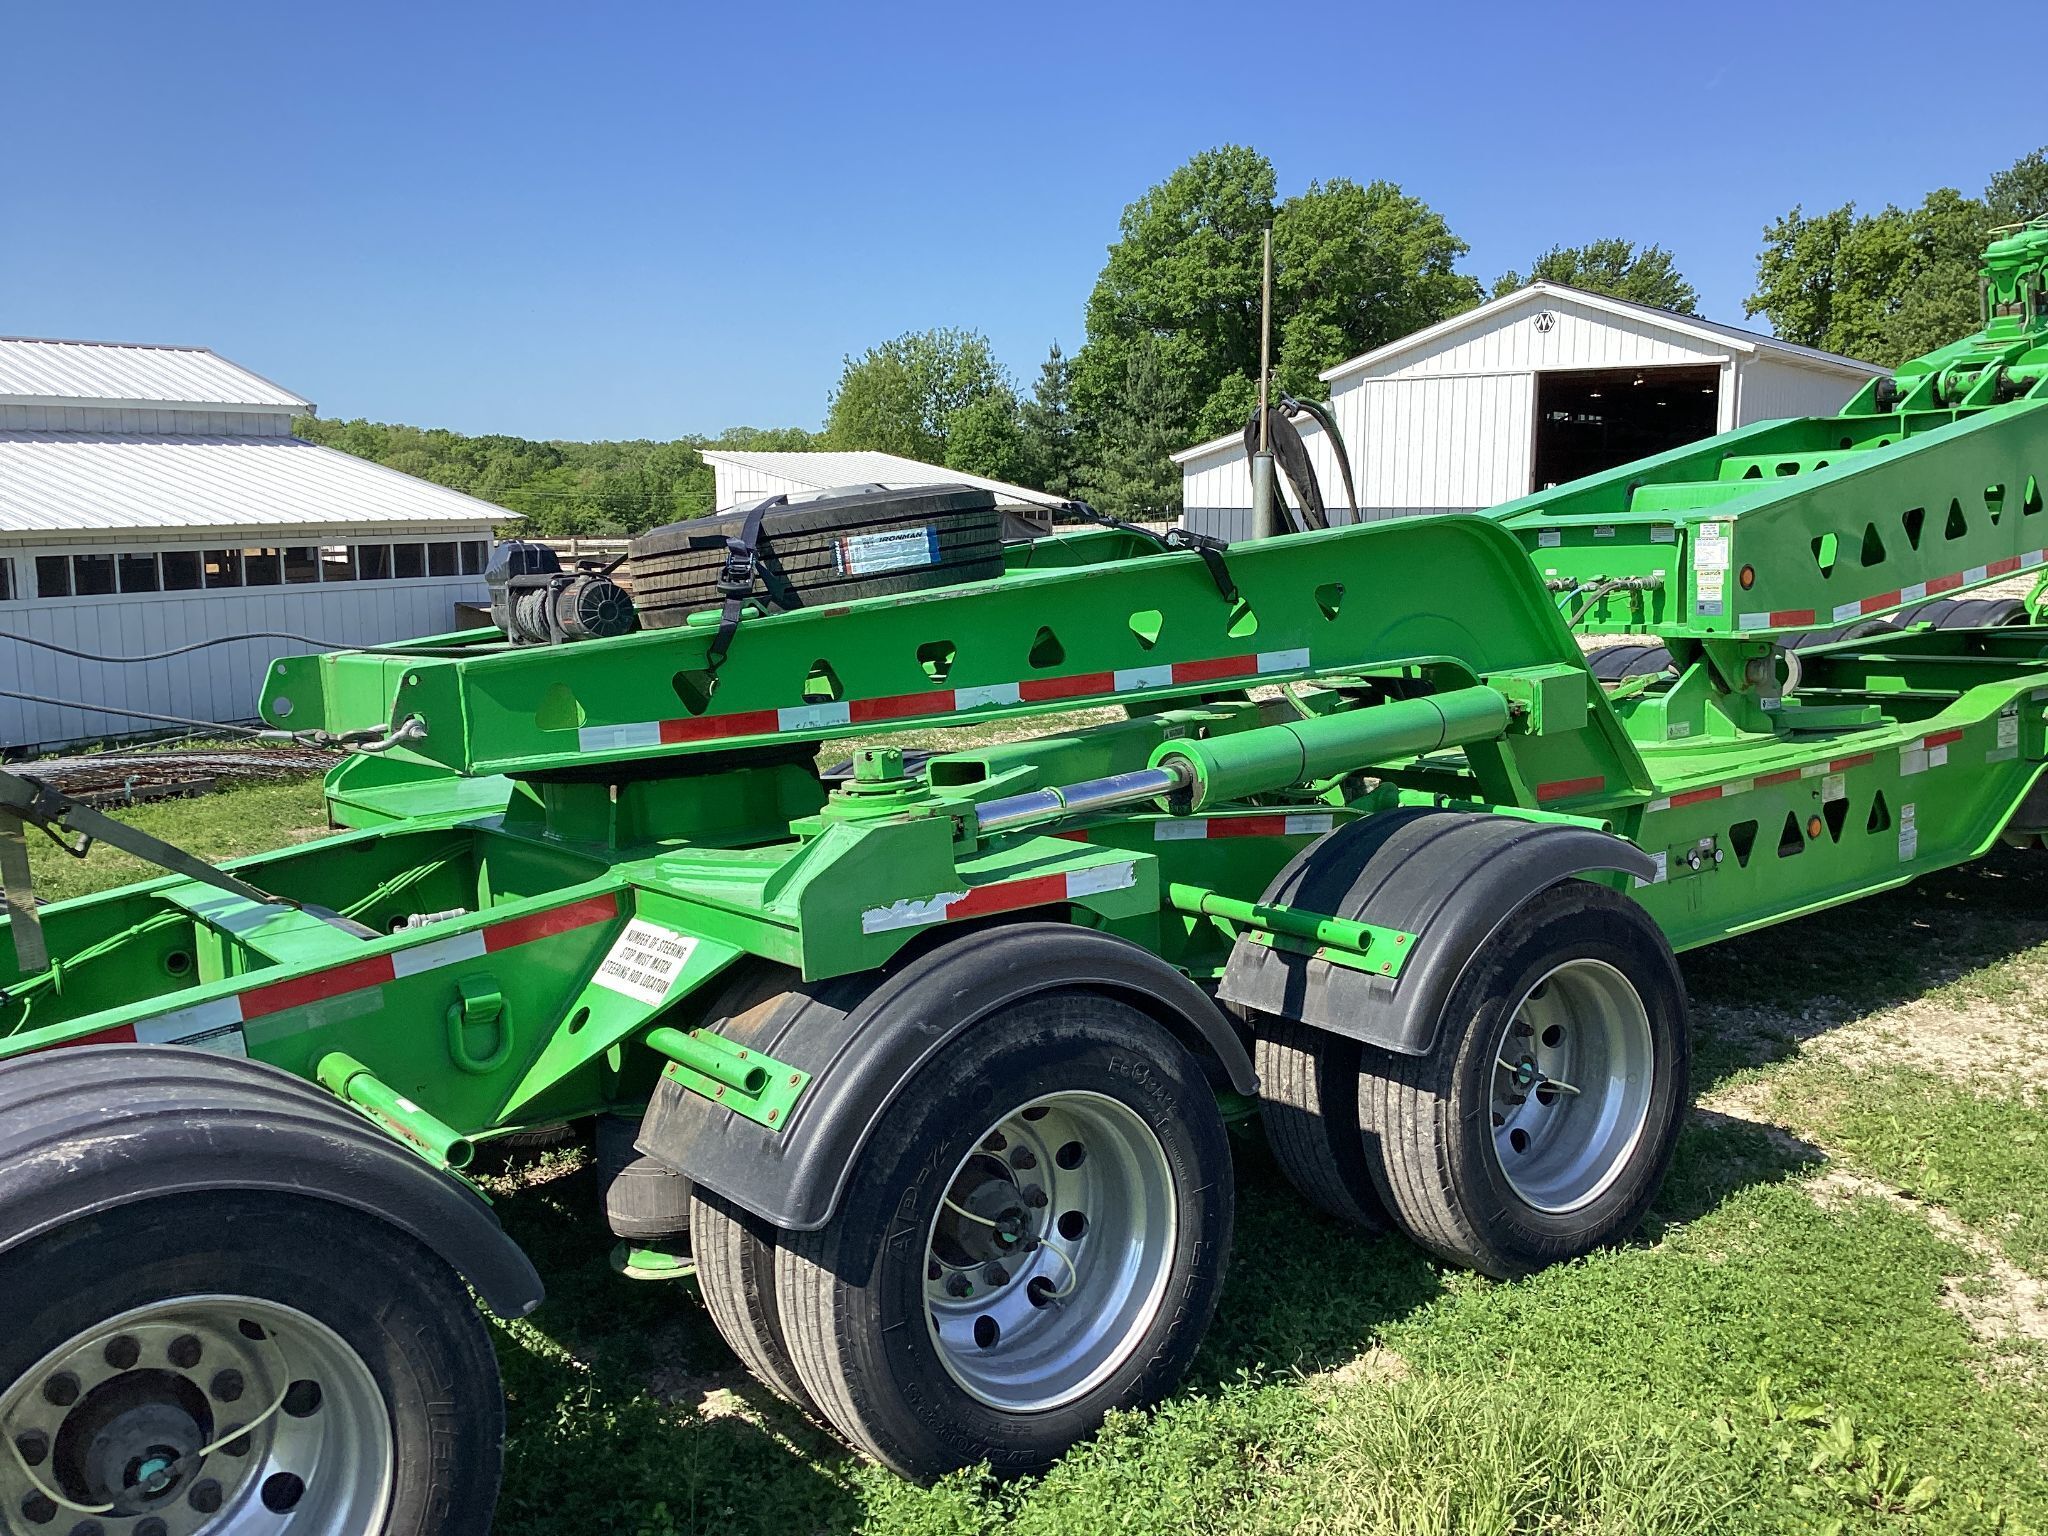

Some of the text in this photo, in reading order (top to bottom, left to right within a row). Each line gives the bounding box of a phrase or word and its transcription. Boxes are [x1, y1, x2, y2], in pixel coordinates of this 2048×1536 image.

[879, 532, 923, 542] IRONMAN
[626, 929, 687, 959] NUMBER OF STEERING
[620, 946, 673, 974] STOP MUST MATCH
[601, 960, 670, 995] STEERING ROD LOCATION
